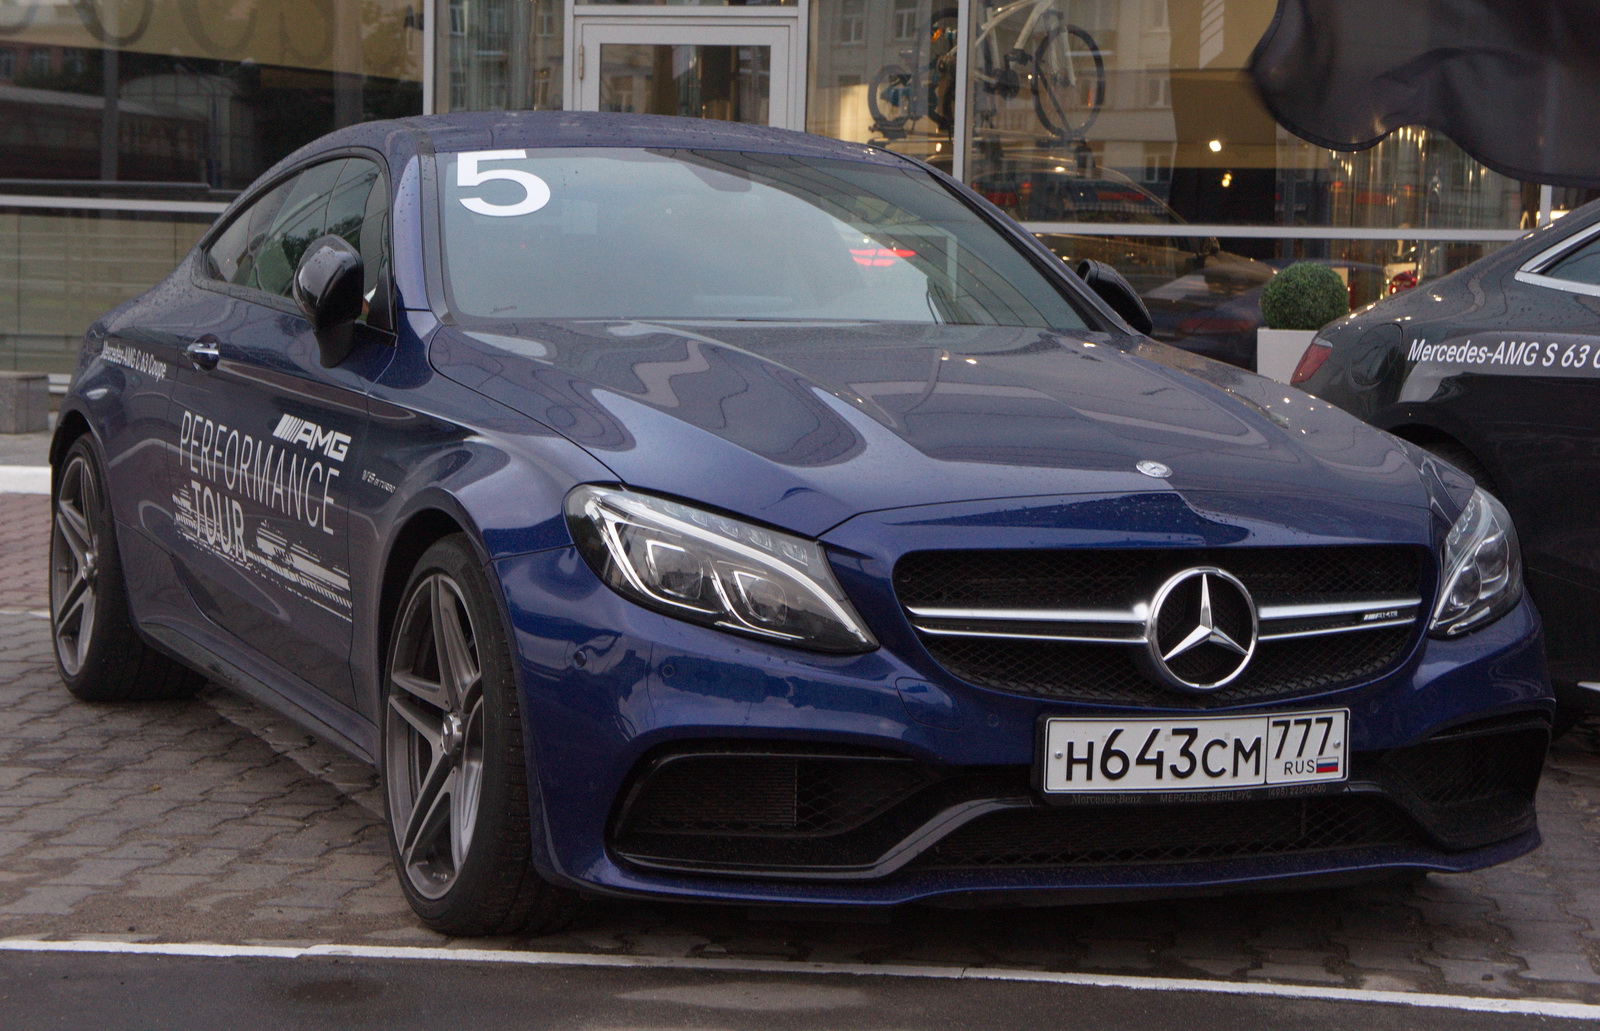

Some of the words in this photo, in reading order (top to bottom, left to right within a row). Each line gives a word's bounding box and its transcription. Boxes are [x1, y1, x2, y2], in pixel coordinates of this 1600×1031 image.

[457, 149, 551, 216] 5
[1407, 338, 1540, 366] Mercedes-AMG
[1542, 343, 1558, 367] S
[1561, 344, 1591, 369] 63
[179, 410, 340, 535] PERFORMANCE
[191, 480, 248, 562] TOUR
[1272, 716, 1334, 760] 777
[1283, 758, 1315, 775] RUS
